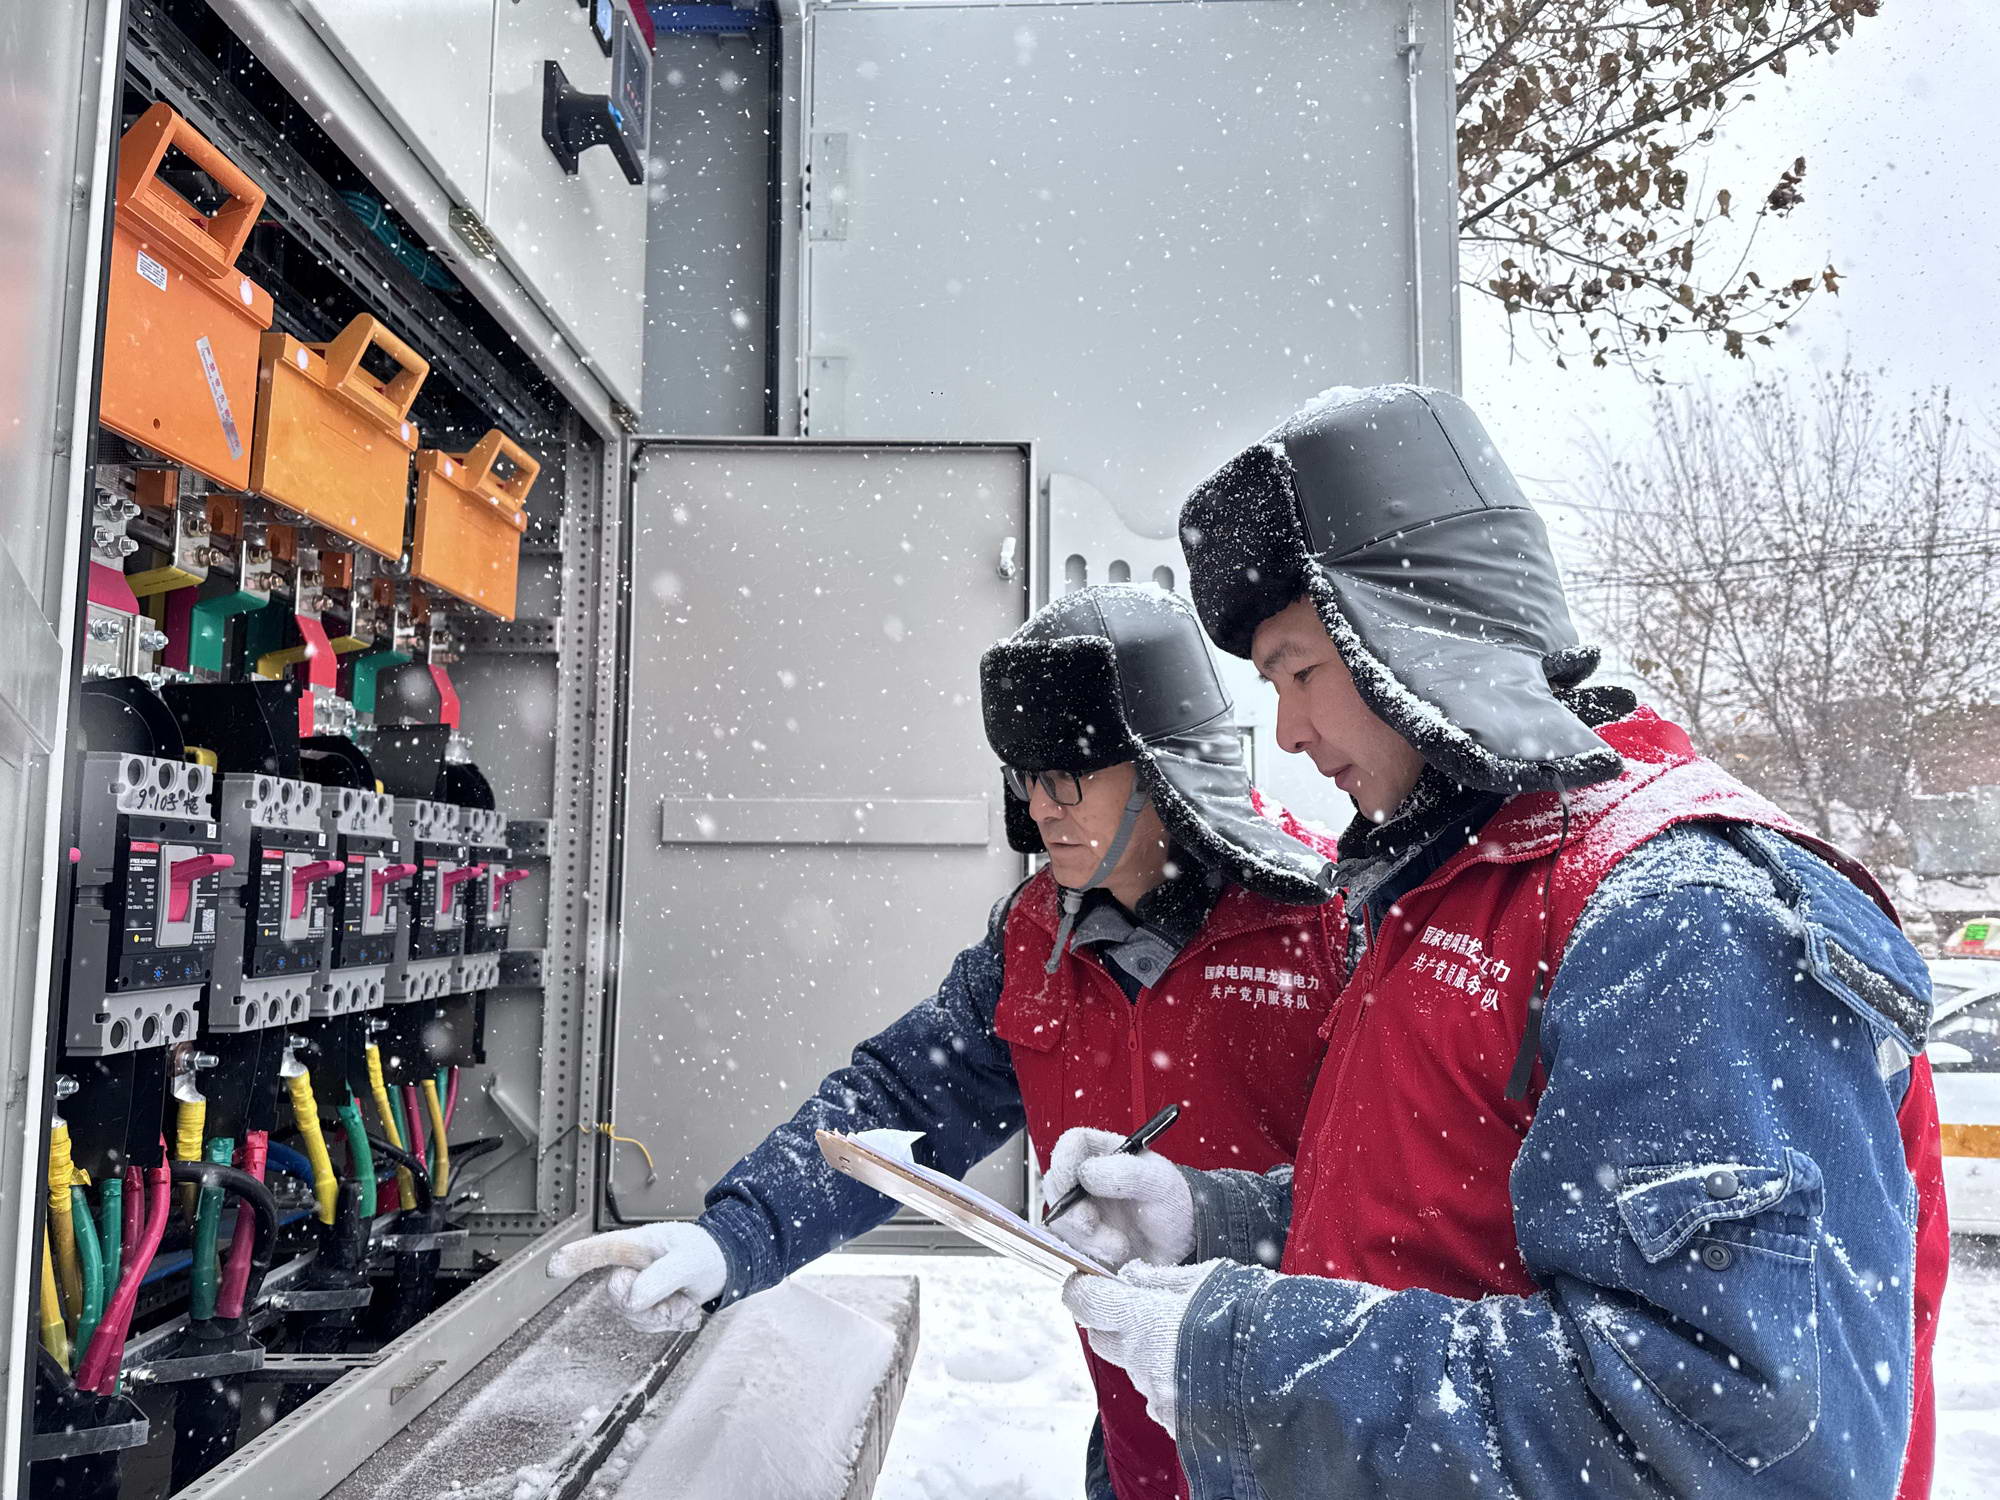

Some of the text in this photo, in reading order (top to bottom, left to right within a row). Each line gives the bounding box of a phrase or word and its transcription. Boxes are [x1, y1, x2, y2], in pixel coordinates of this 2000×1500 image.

[1204, 964, 1319, 990] 国家电网黑龙江电力
[1409, 952, 1499, 1011] 共产党员服务队
[1210, 984, 1310, 1010] 共产党员服务队
